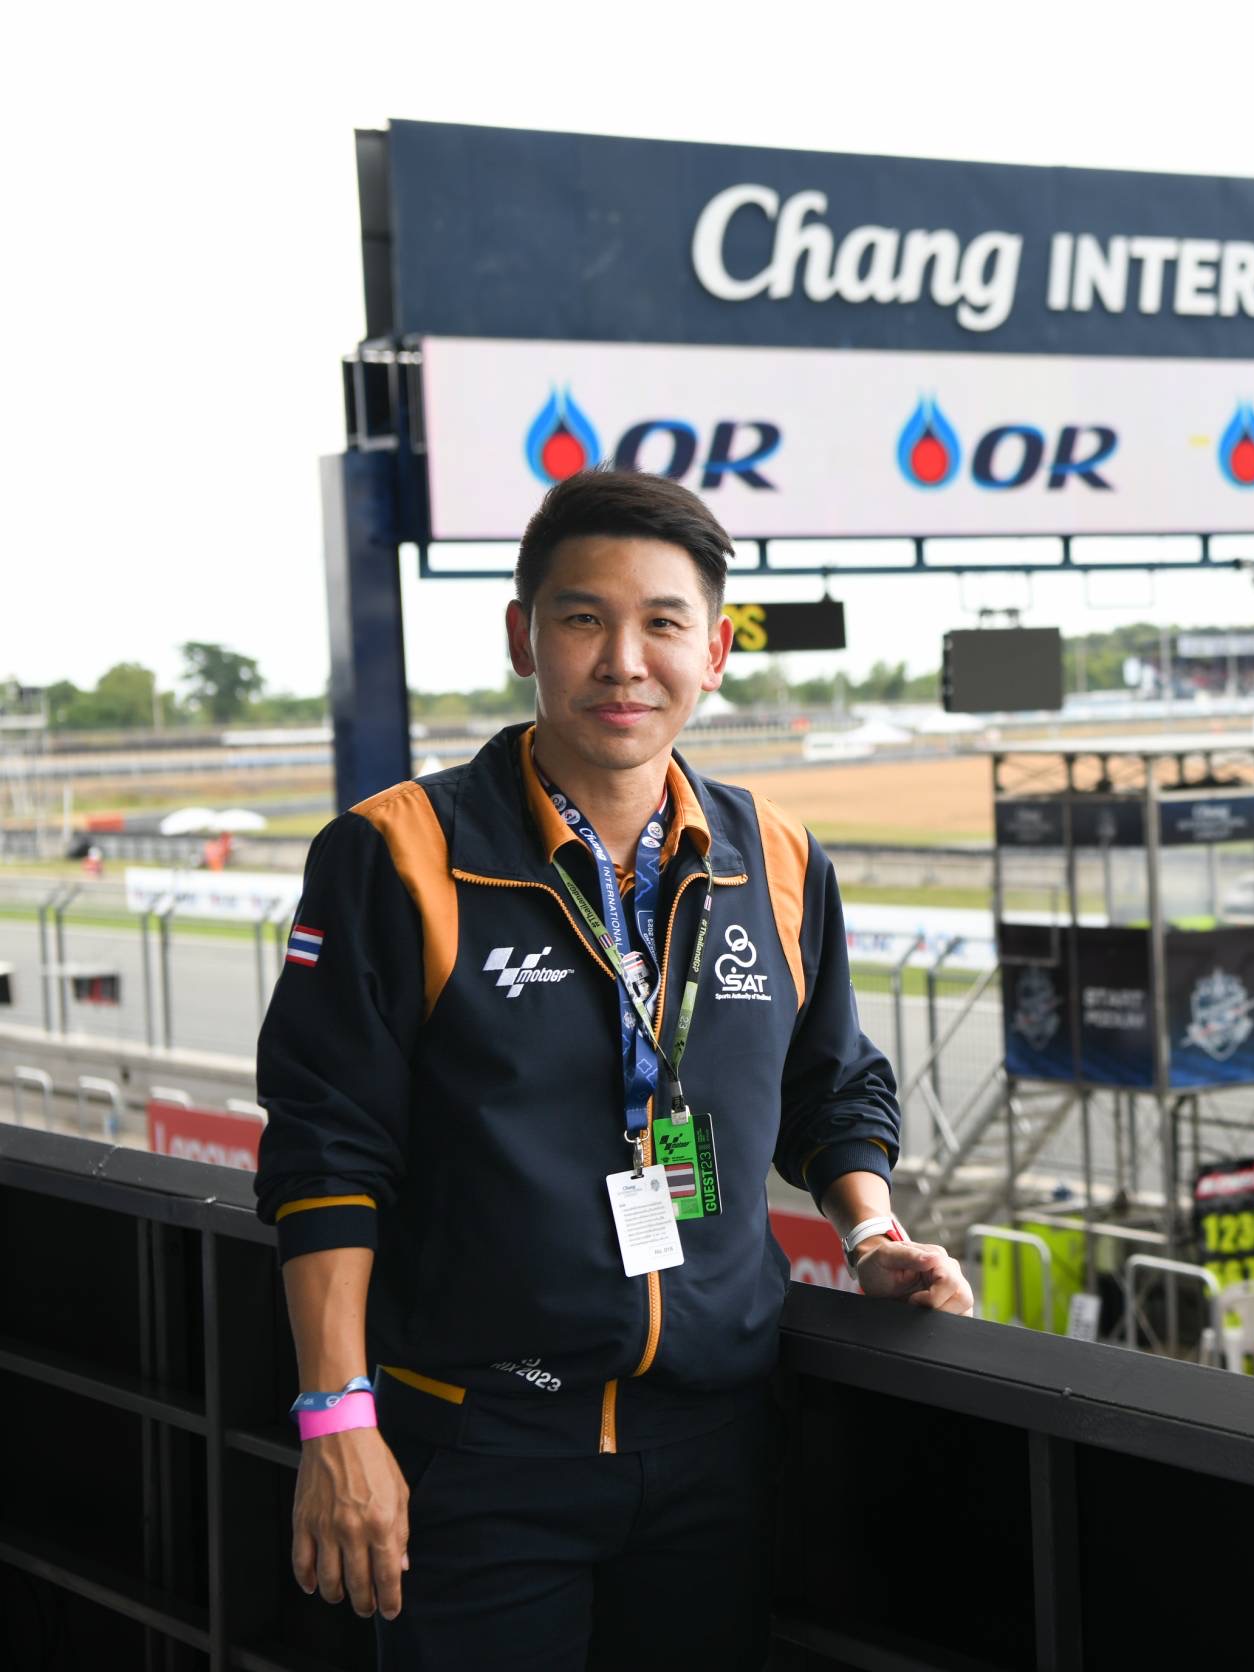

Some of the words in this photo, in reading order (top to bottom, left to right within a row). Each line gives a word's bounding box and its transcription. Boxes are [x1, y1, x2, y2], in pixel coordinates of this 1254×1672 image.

[692, 183, 1022, 332] Chang
[615, 421, 782, 490] OR
[971, 425, 1120, 491] OR
[603, 866, 623, 948] INTERNATIONAL
[722, 974, 767, 992] SAT
[516, 1367, 562, 1392] 2023
